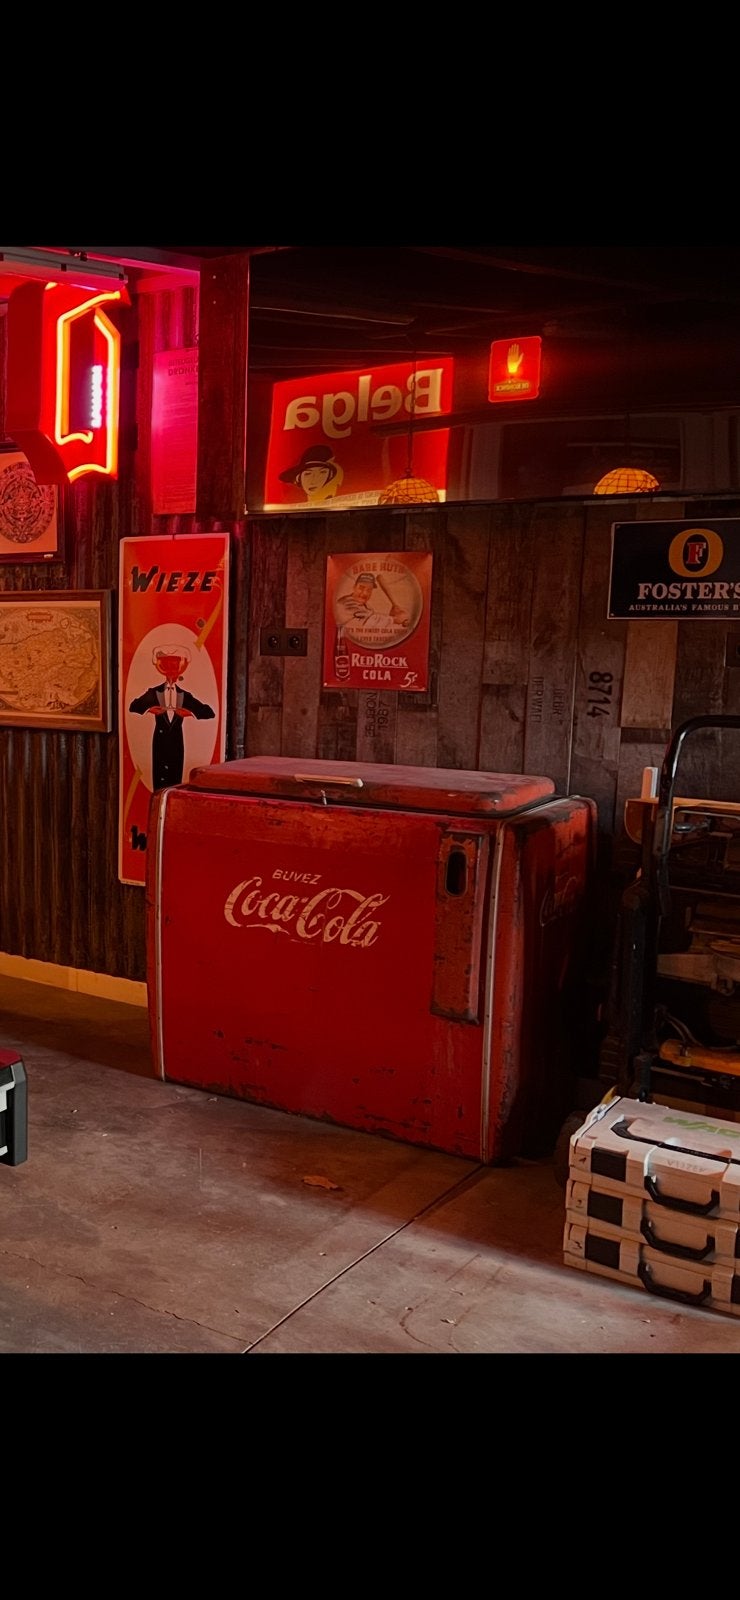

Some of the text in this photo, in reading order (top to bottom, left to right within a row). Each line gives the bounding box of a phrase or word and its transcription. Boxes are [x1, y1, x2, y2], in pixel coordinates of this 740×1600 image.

[130, 565, 217, 593] WIEZE
[628, 603, 740, 611] AUSTRALIA'S FAMOUS B
[362, 670, 392, 681] COLA
[587, 672, 614, 718] 8714
[272, 869, 323, 885] BUVEZ
[224, 876, 391, 948] Coca-Cola
